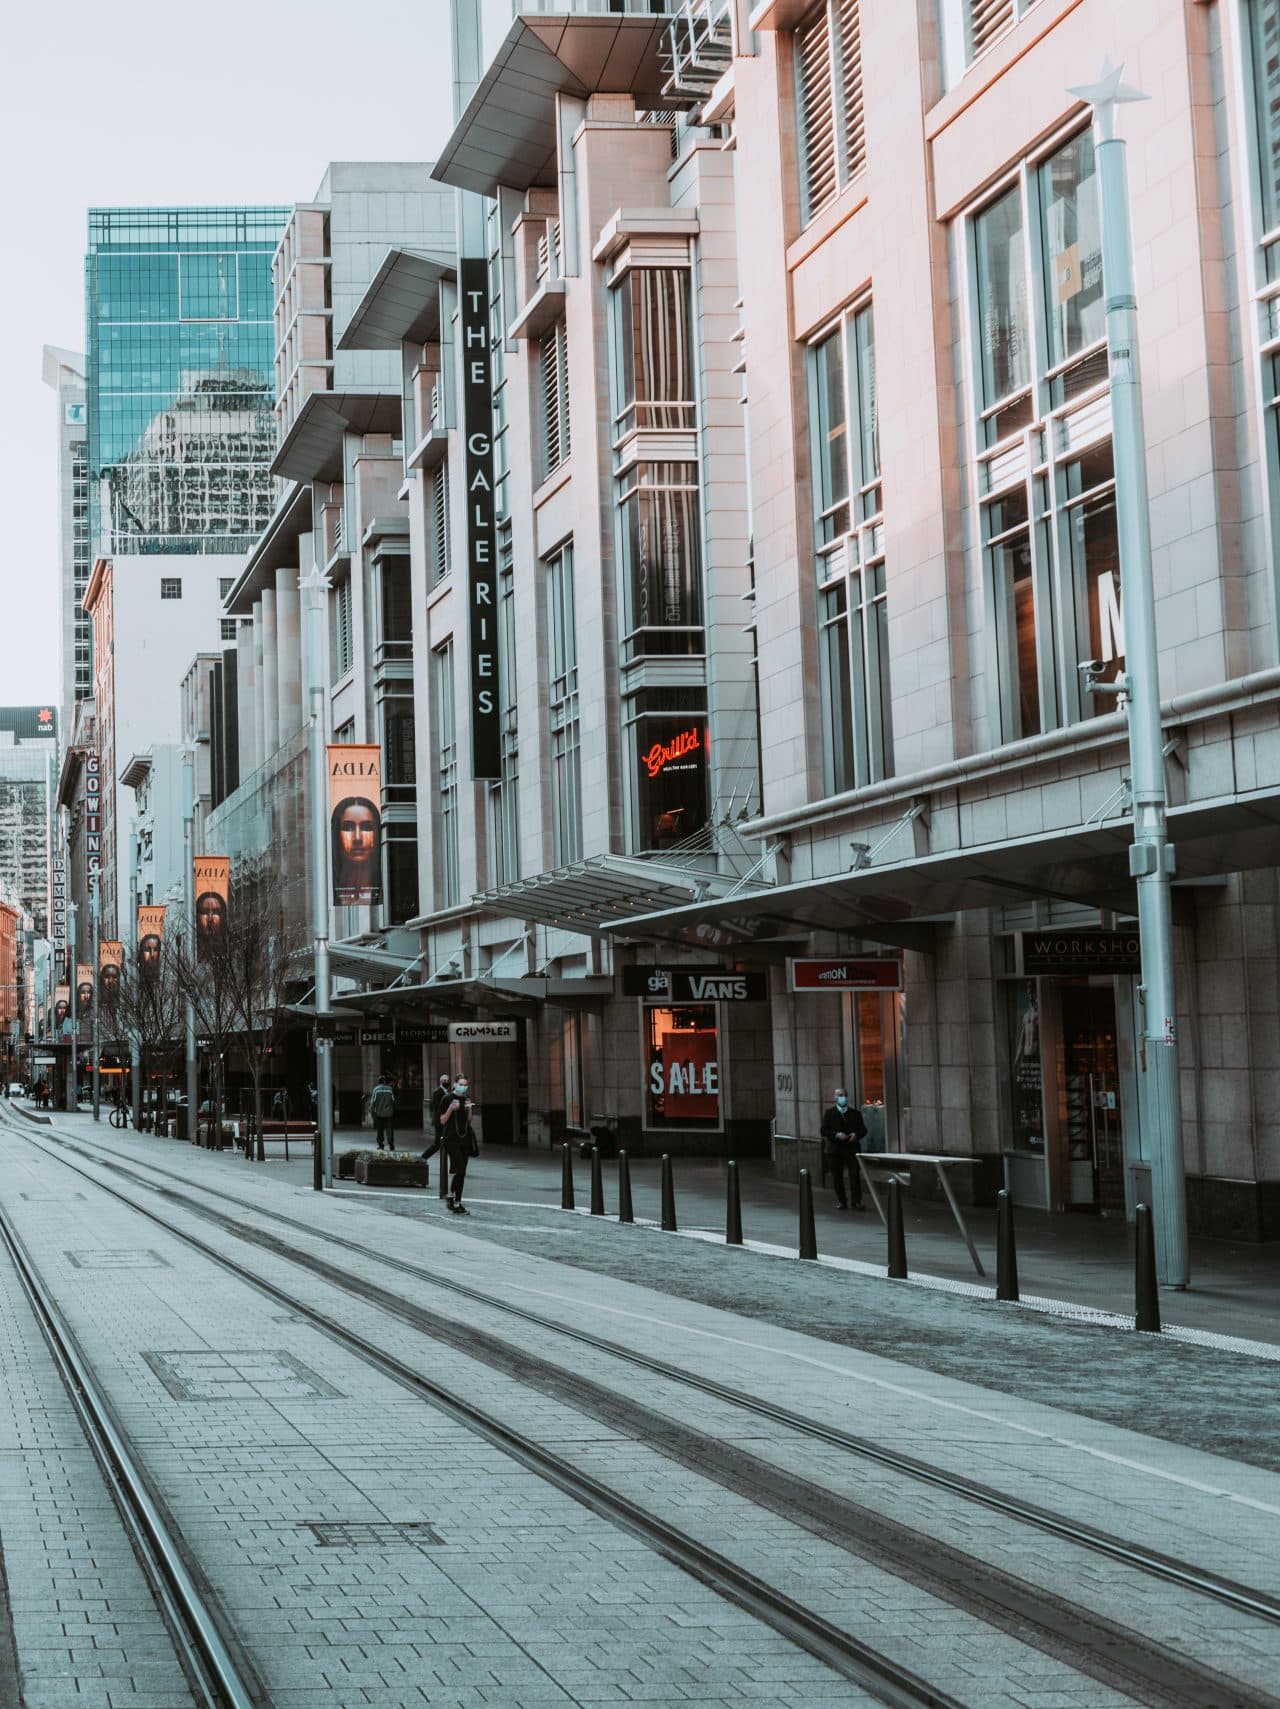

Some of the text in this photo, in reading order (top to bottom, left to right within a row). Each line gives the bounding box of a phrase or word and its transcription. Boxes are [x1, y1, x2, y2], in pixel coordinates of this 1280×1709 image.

[466, 290, 494, 713] THE GALERIES
[38, 724, 53, 732] nab
[55, 861, 65, 947] DYMOCKS
[688, 976, 748, 1000] VANS
[456, 1027, 510, 1037] CRUMPLER
[651, 1062, 719, 1095] SALE
